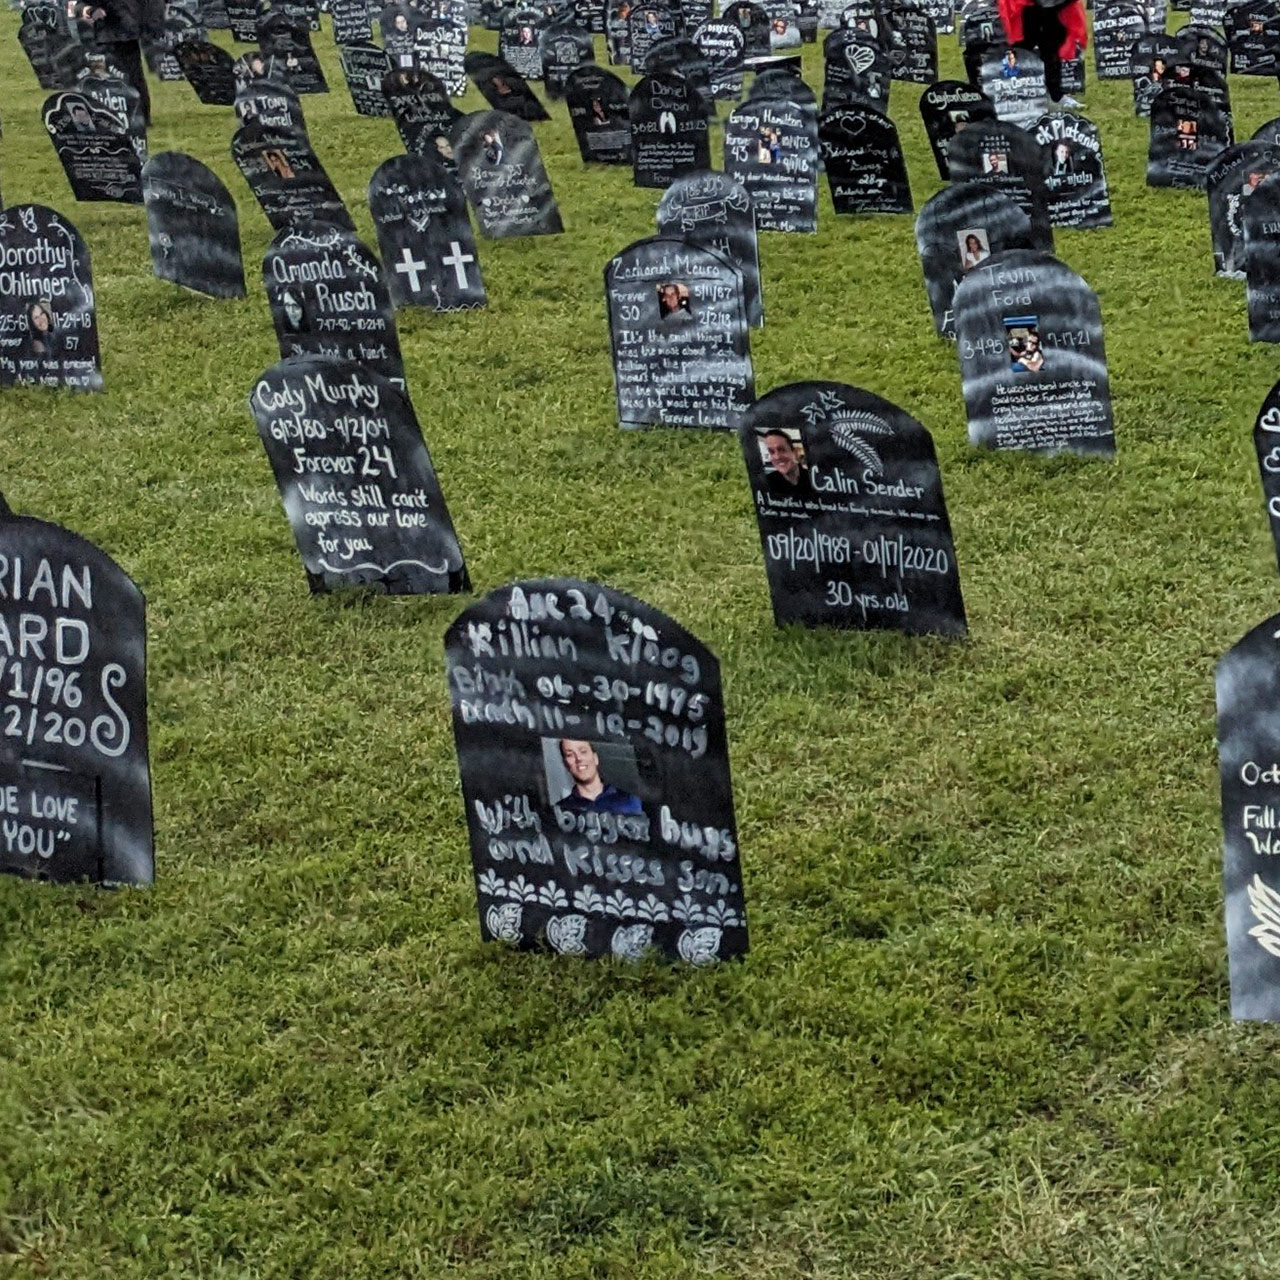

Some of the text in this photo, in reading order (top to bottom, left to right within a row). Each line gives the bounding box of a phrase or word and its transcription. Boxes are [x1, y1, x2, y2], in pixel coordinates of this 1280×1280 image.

[272, 256, 346, 283] Amanda
[316, 284, 376, 313] Rusch
[992, 290, 1032, 306] Ford
[620, 306, 640, 321] 30
[256, 374, 380, 415] Cody Murphy
[293, 446, 398, 479] Forever 24
[811, 465, 924, 499] Calin Sender
[352, 483, 385, 509] still
[825, 581, 852, 606] 30
[32, 791, 78, 823] LOVE
[1243, 805, 1275, 831] Full
